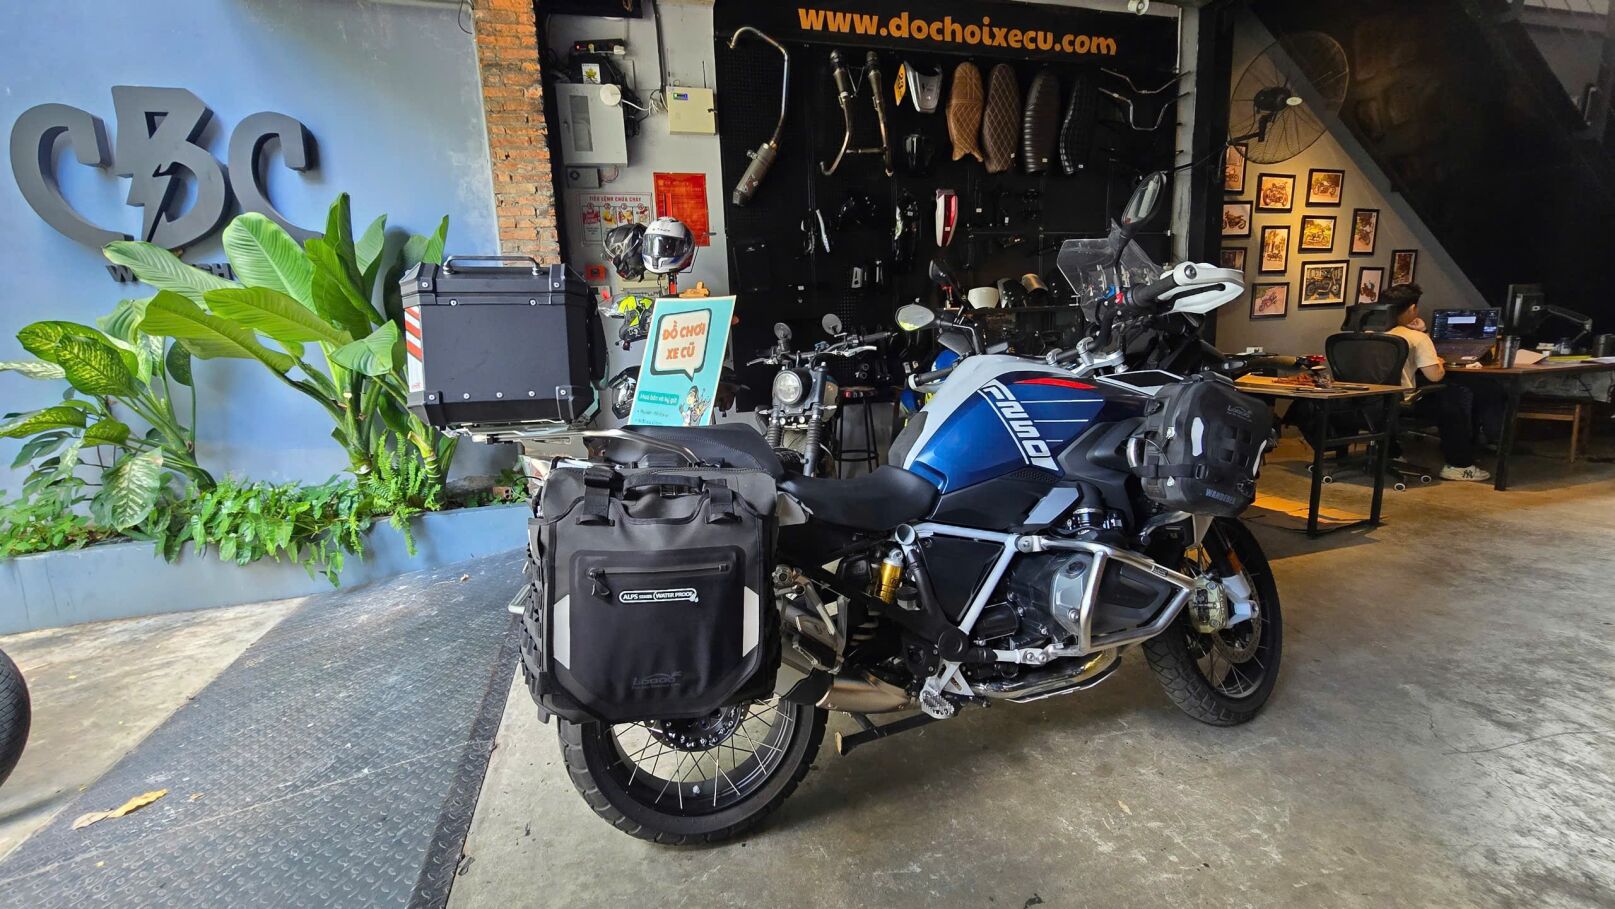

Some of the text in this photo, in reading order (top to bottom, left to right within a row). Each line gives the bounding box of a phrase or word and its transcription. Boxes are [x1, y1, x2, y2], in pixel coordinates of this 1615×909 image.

[798, 8, 1117, 56] www.dochoixecu.com
[662, 321, 678, 341] ĐỒ
[680, 322, 706, 339] CHƠI
[666, 342, 695, 360] XE CŨ
